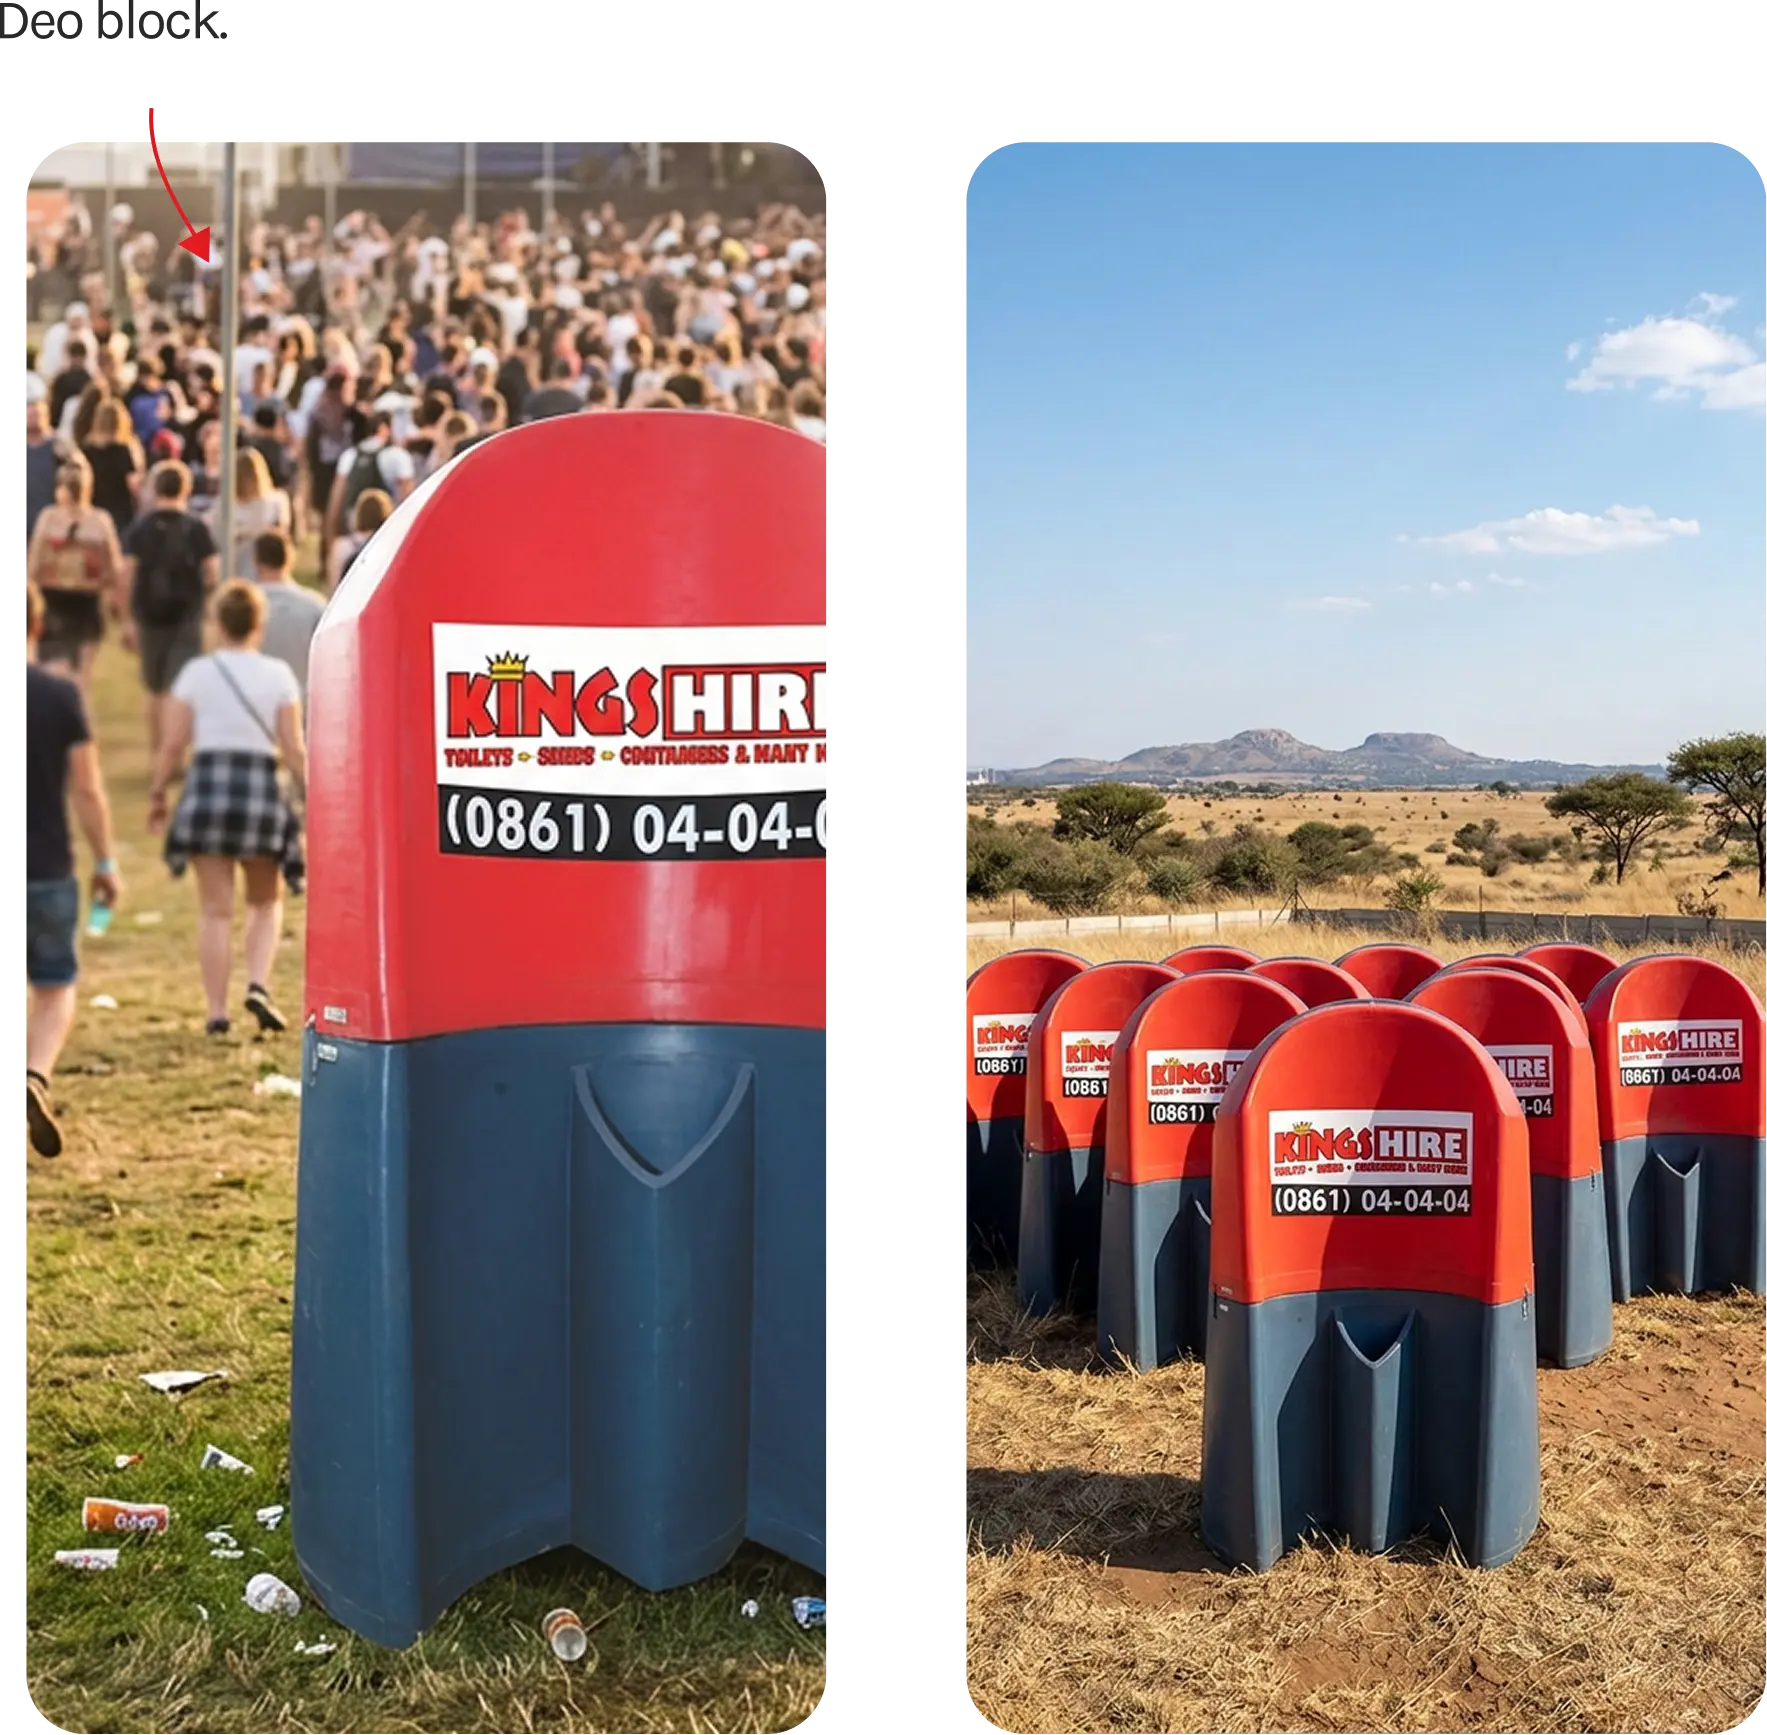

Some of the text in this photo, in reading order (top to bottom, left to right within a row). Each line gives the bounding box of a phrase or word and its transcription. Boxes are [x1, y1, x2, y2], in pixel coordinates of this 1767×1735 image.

[446, 667, 659, 738] KINGS
[447, 793, 611, 854] (0861)
[1681, 1031, 1736, 1049] HIRE
[1151, 1062, 1222, 1087] KINGS
[1151, 1104, 1205, 1123] (0861)
[1274, 1127, 1462, 1164] KINGS HIRE
[1275, 1187, 1470, 1213] (0861) 04-04-04
